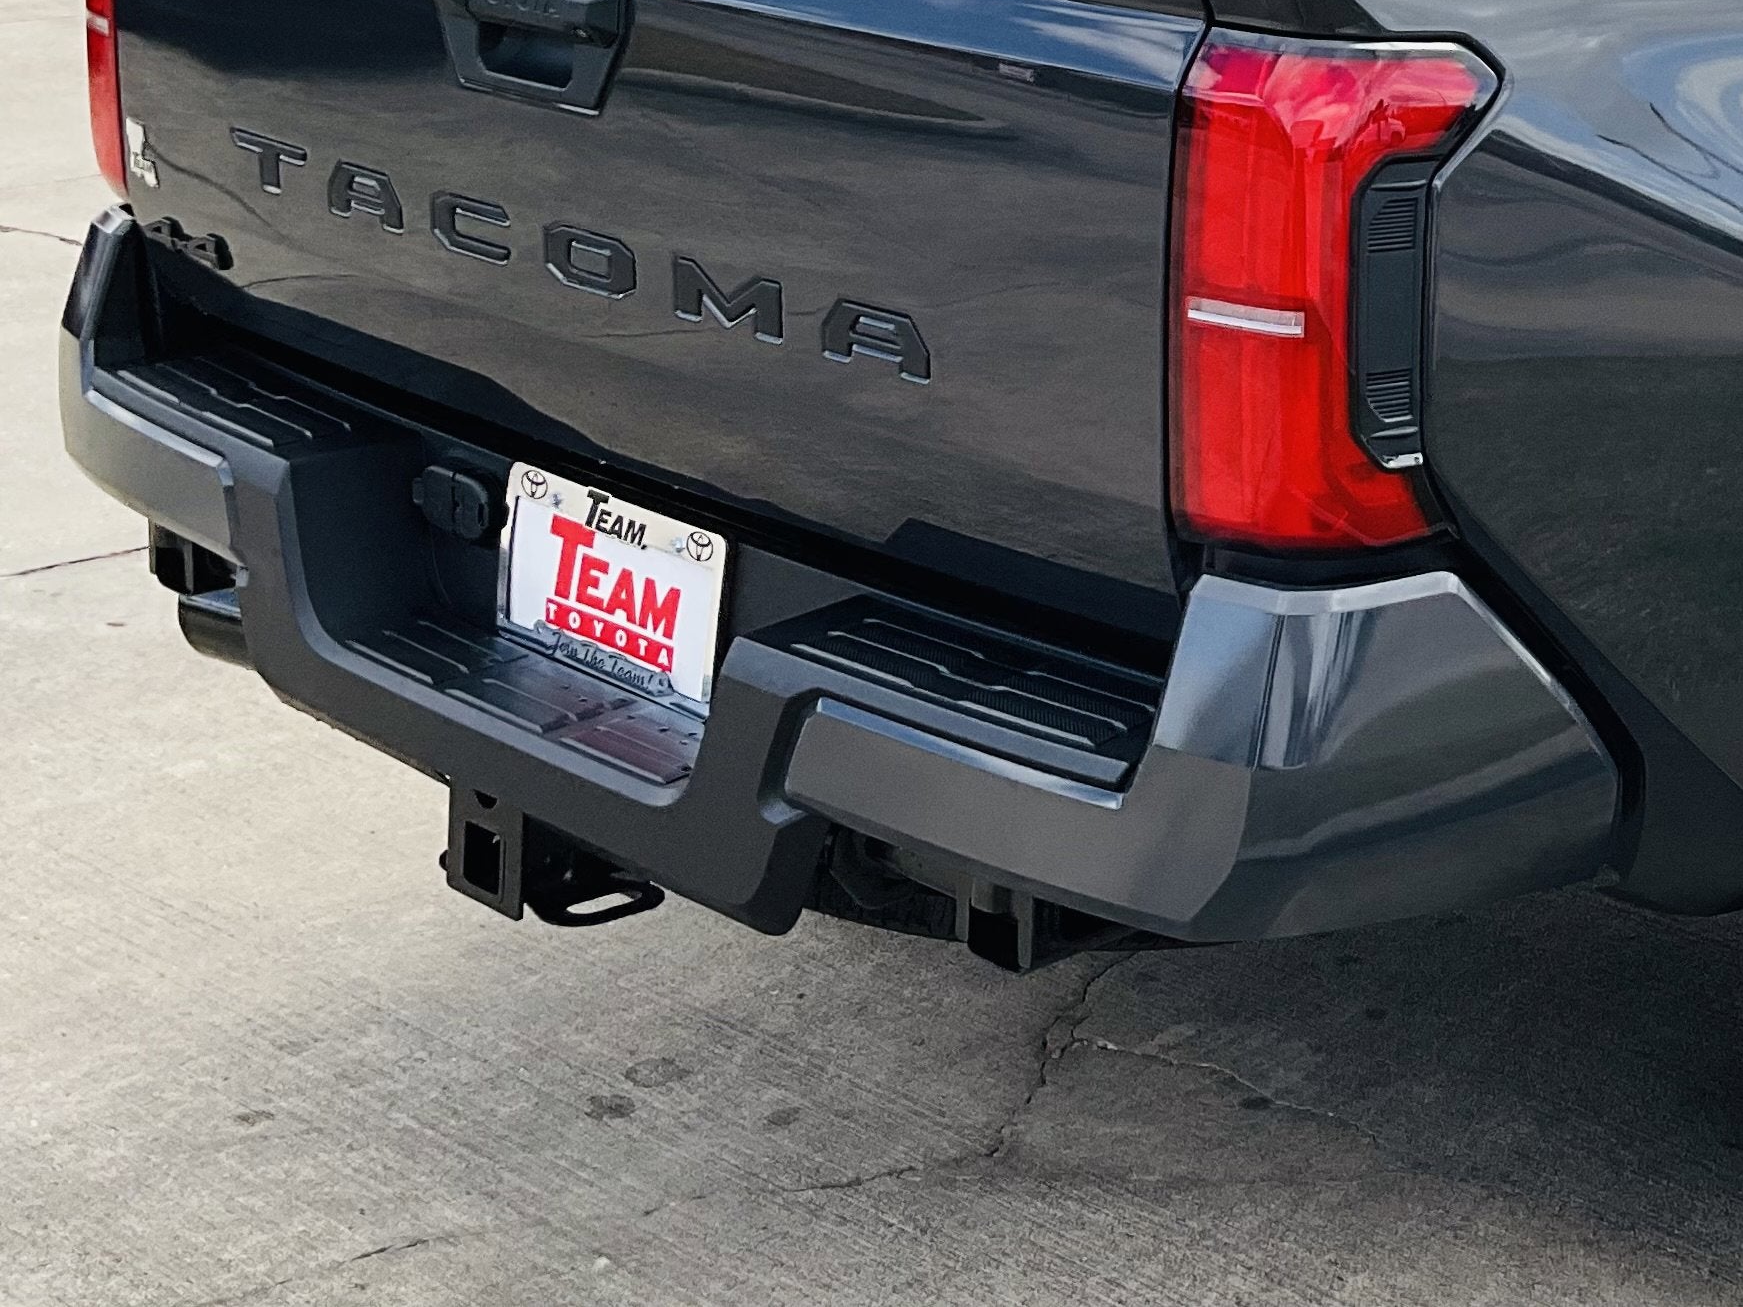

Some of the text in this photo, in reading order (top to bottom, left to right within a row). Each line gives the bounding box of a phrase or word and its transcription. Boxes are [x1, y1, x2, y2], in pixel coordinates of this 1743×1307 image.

[229, 126, 931, 385] TACOMA
[550, 513, 681, 642] TEAM
[547, 602, 670, 667] TOYOTA
[581, 642, 606, 670] The
